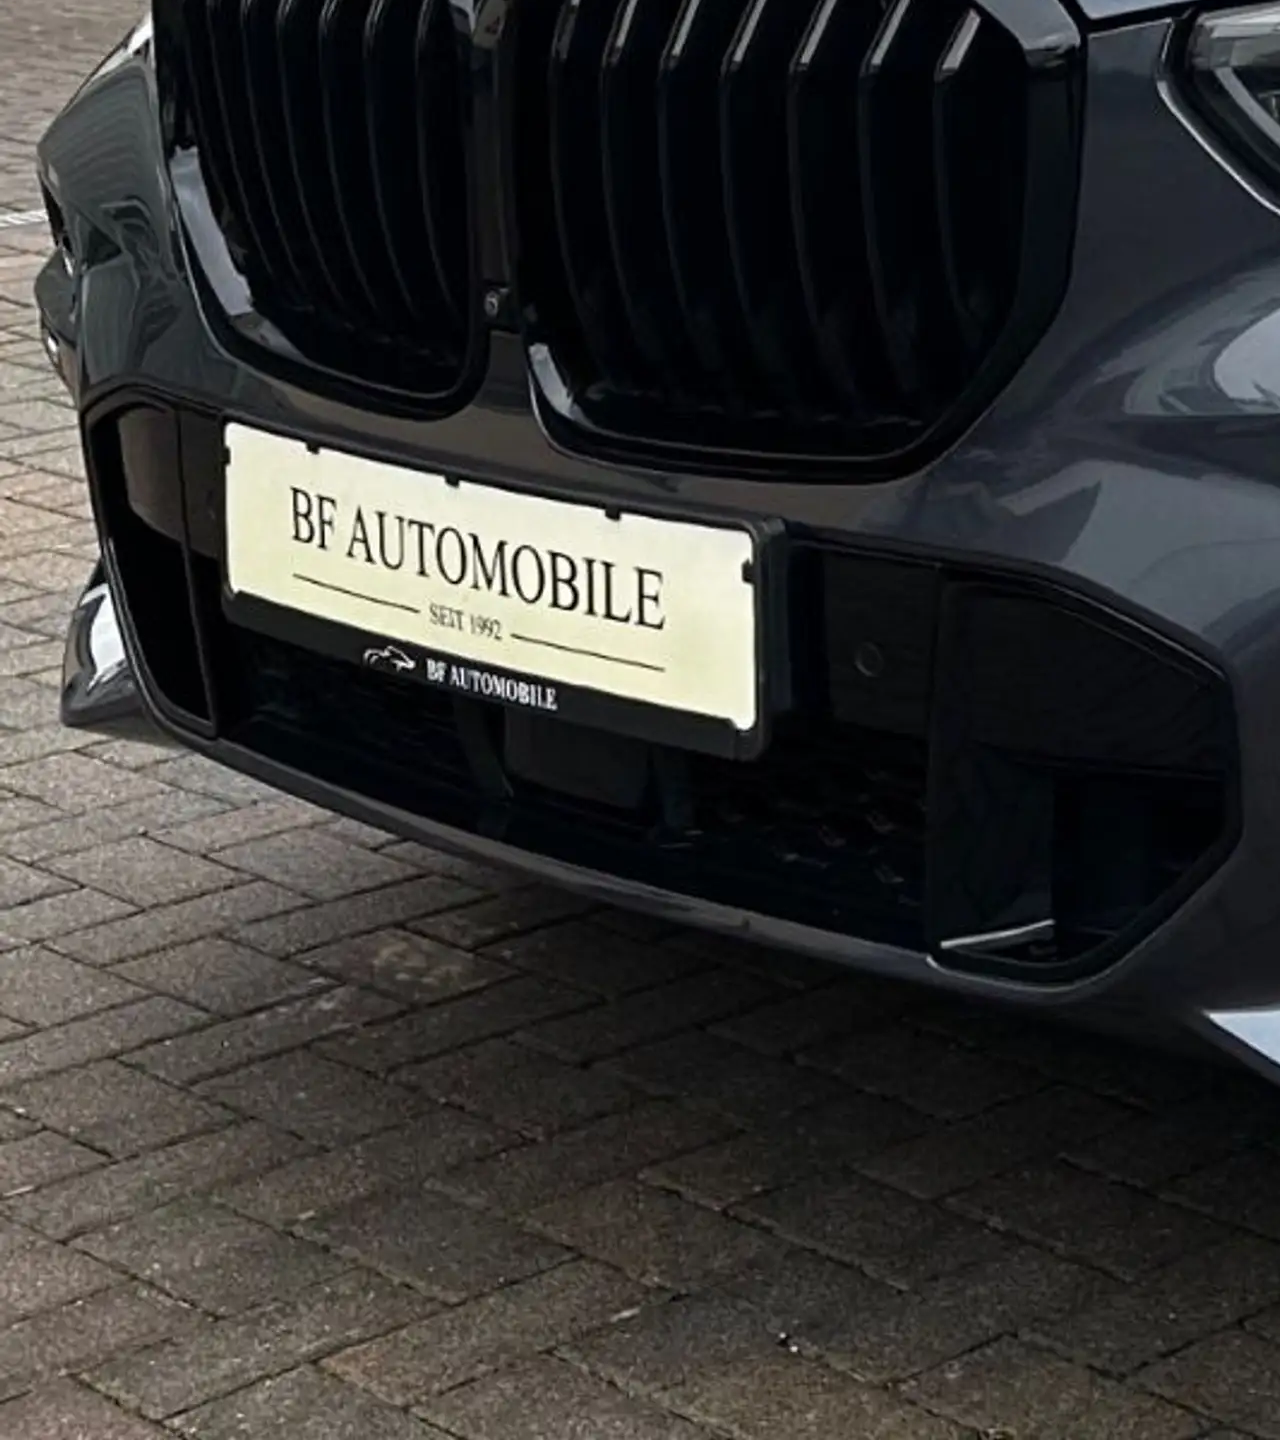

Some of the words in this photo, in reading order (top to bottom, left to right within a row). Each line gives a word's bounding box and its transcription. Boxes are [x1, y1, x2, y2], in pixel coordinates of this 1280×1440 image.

[290, 486, 337, 550] BF
[346, 504, 667, 631] AUTOMOBILE
[429, 603, 464, 631] SEIT
[470, 613, 503, 641] 1992
[426, 658, 447, 683] BF
[449, 664, 558, 711] AUTOMOBILE
